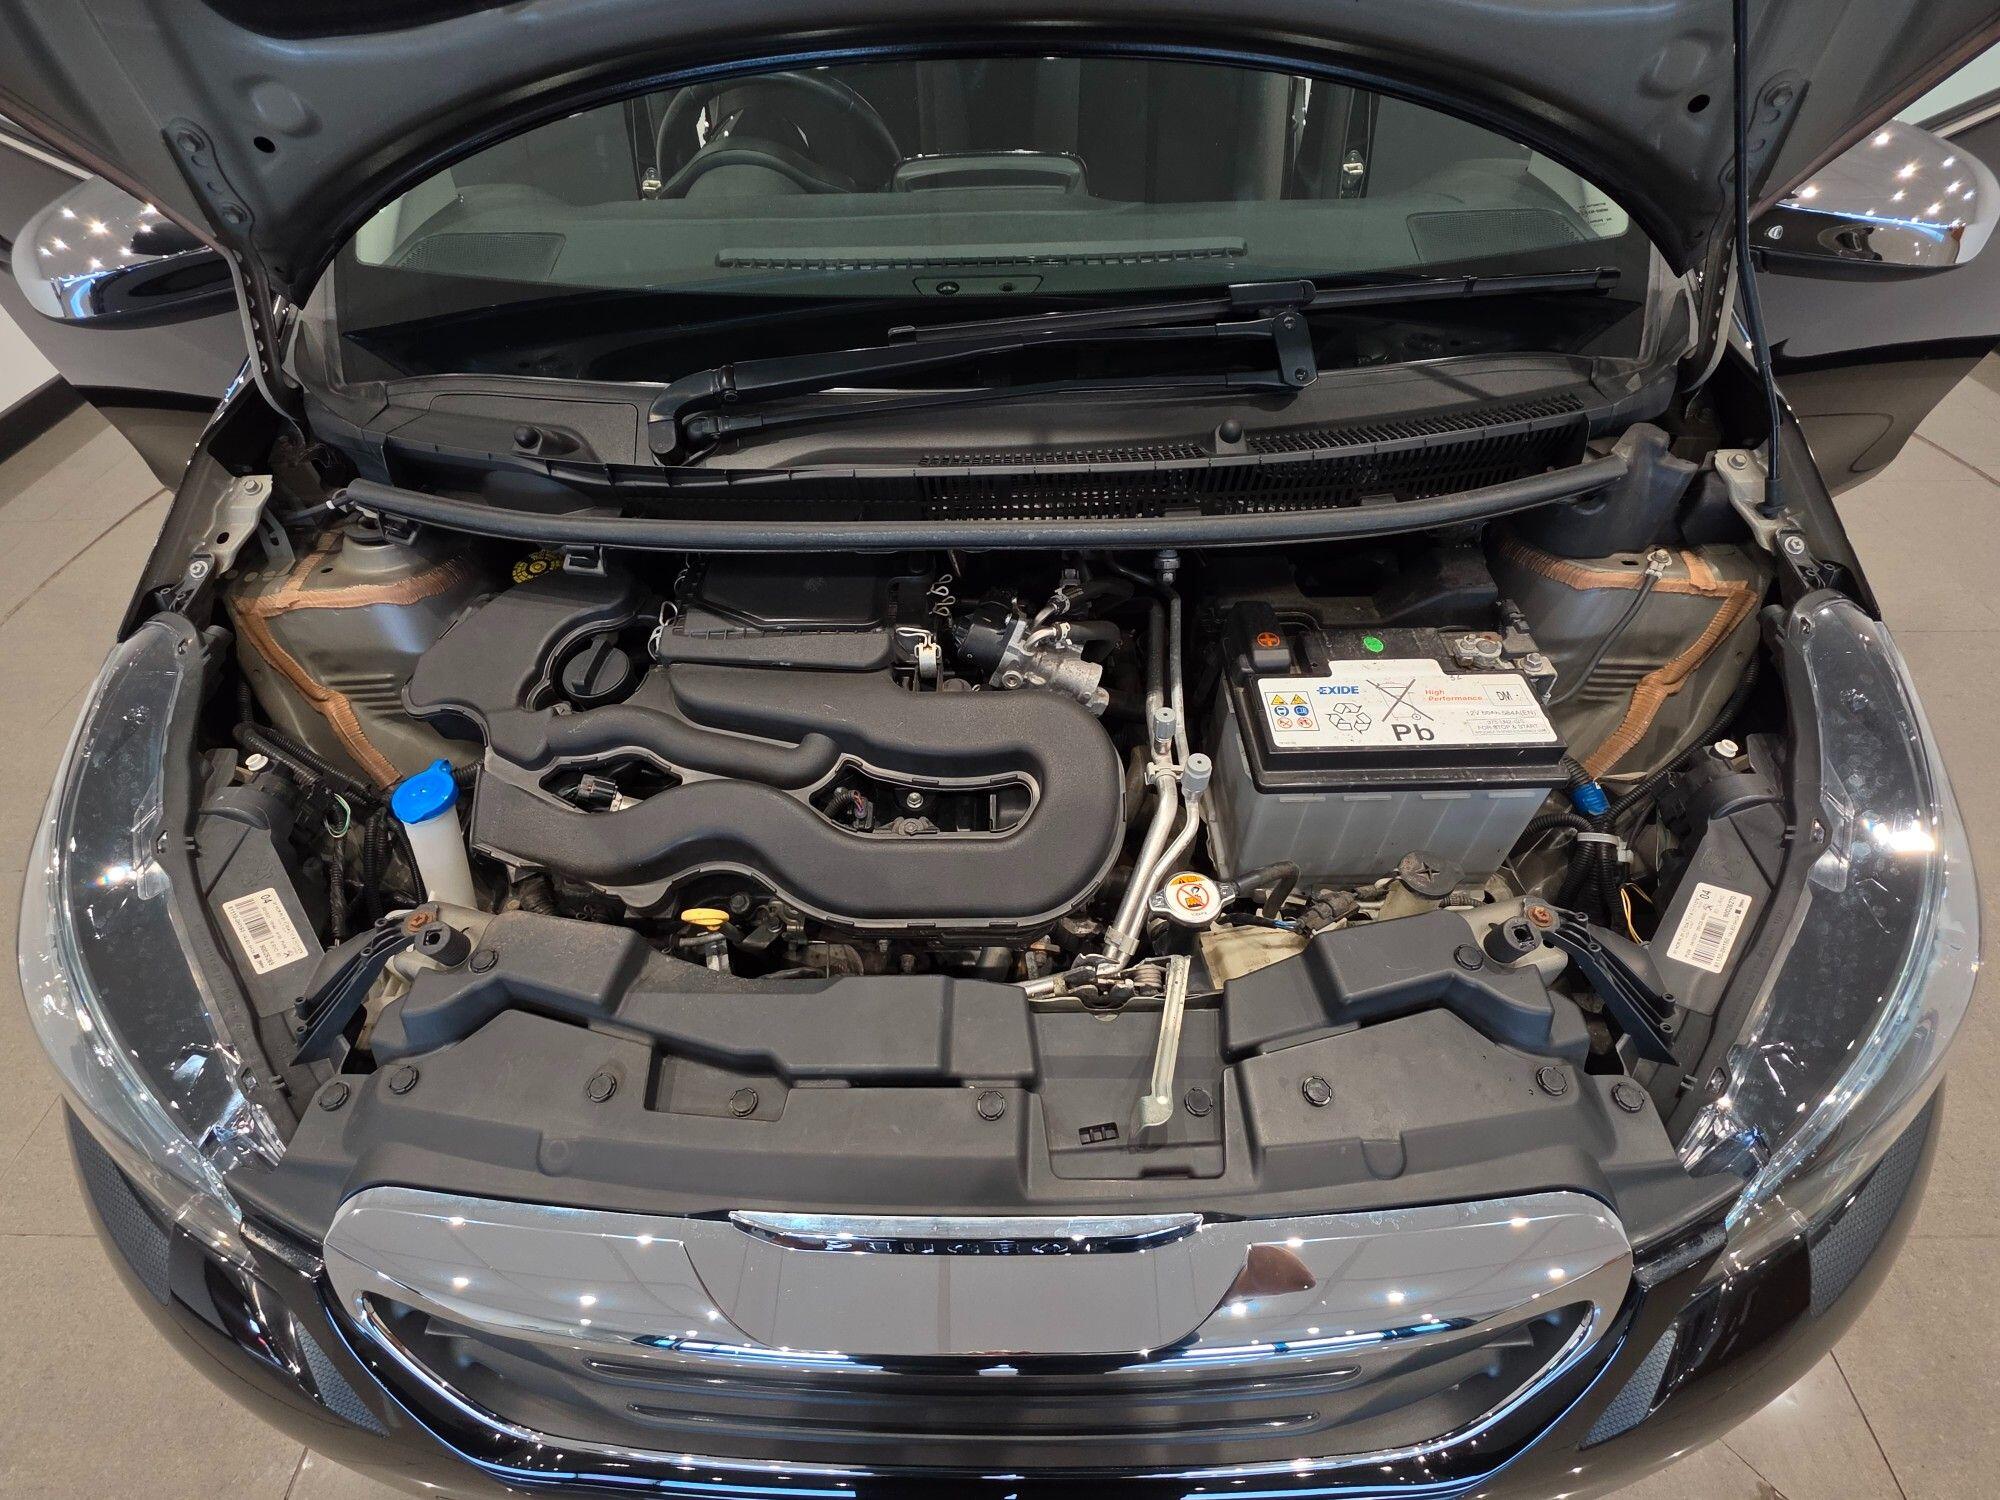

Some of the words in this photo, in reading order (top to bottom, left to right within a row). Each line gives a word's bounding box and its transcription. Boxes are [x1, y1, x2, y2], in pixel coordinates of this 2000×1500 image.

[1317, 686, 1359, 695] EXIDE
[1391, 724, 1435, 742] Pb
[1699, 889, 1711, 900] 04
